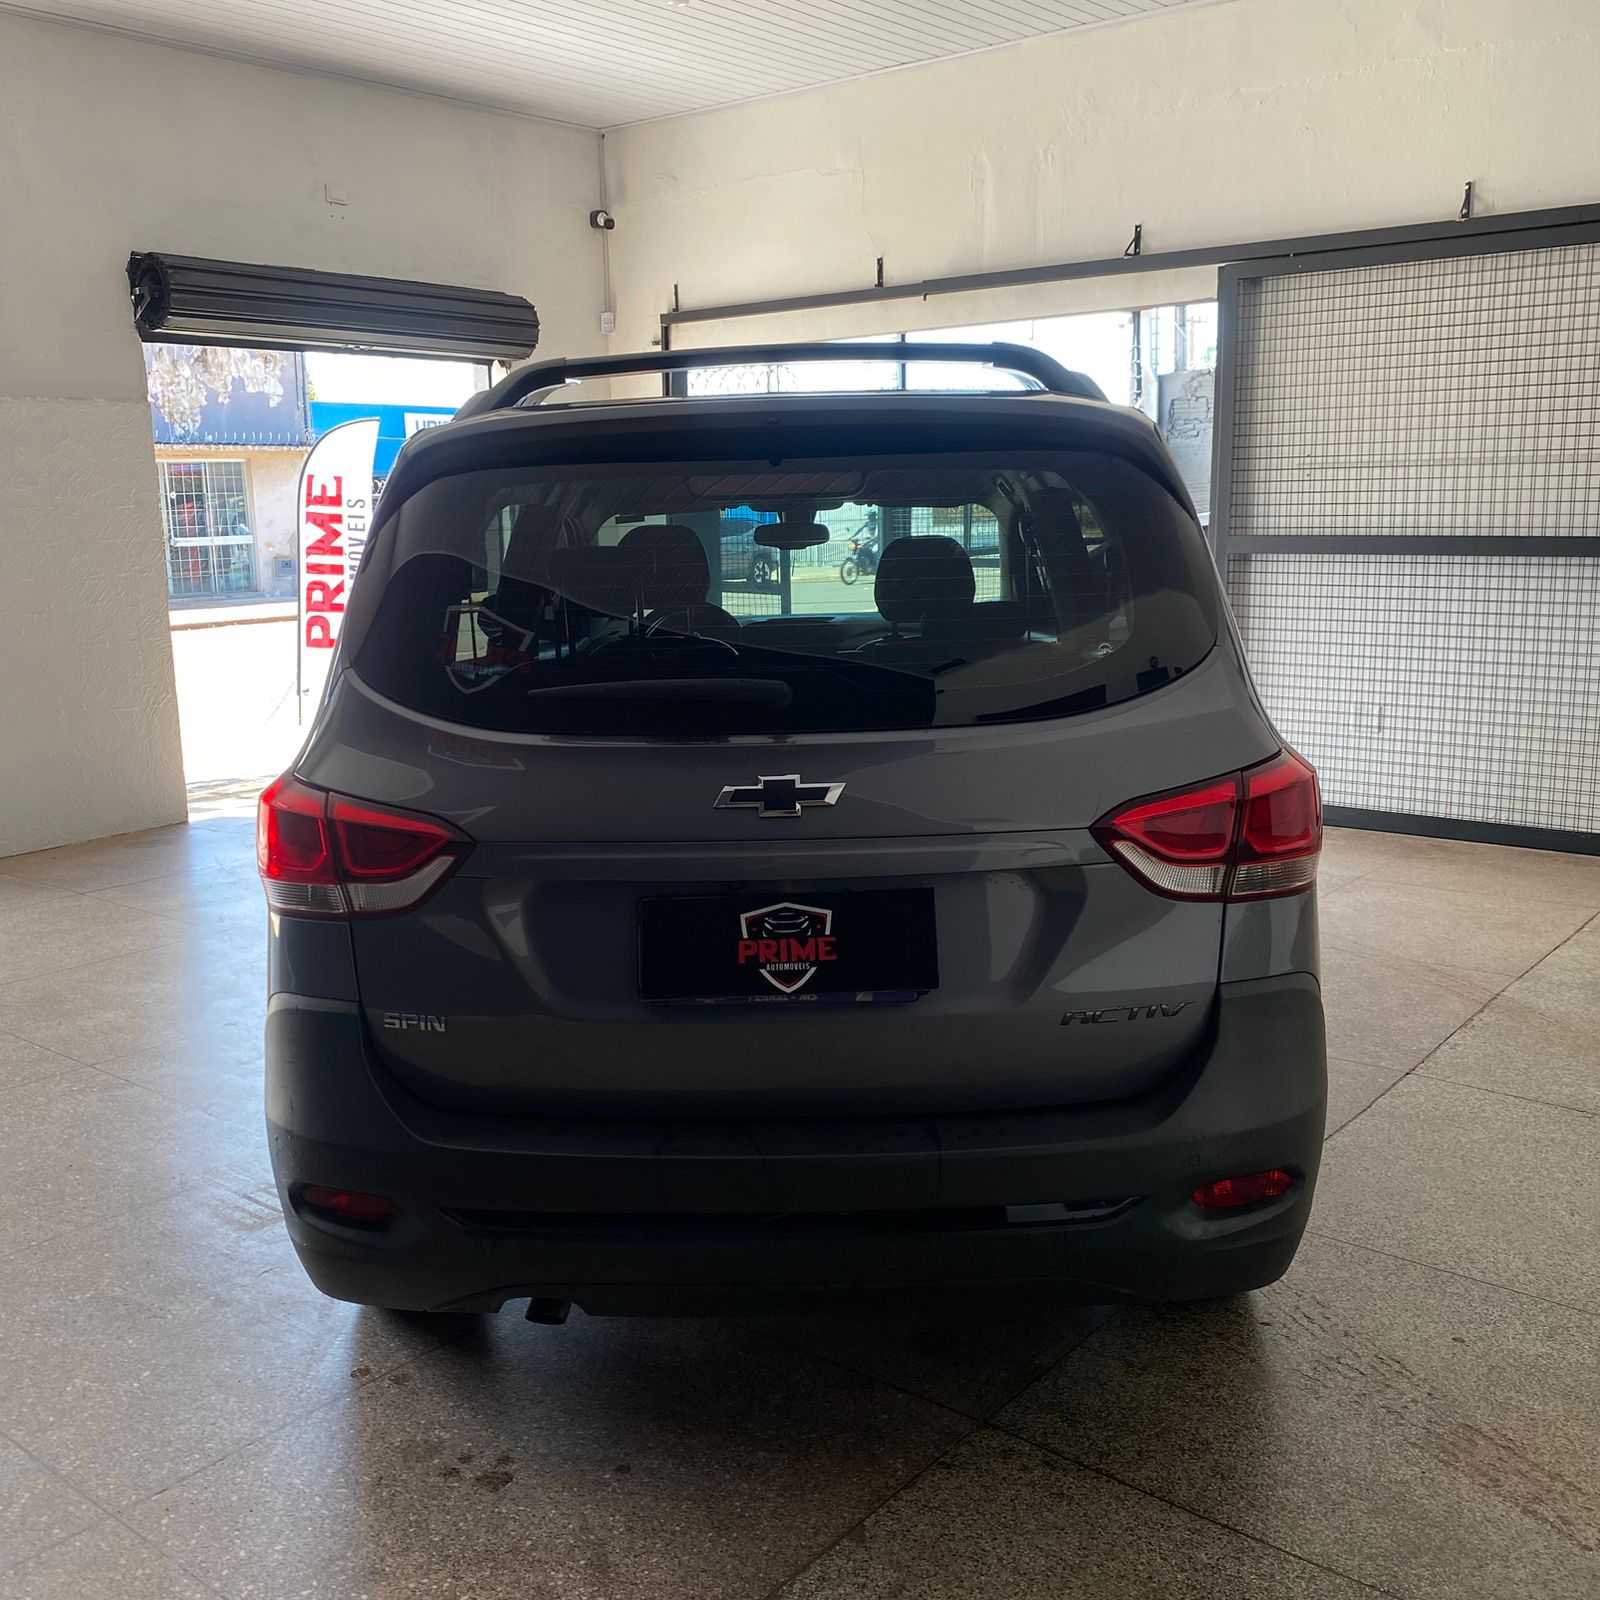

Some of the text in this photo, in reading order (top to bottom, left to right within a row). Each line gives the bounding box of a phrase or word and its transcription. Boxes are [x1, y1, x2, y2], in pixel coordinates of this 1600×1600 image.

[306, 475, 345, 648] PRIME
[738, 938, 837, 962] PRIME
[384, 1012, 446, 1032] SPIN
[1060, 1001, 1193, 1026] ACTIV
